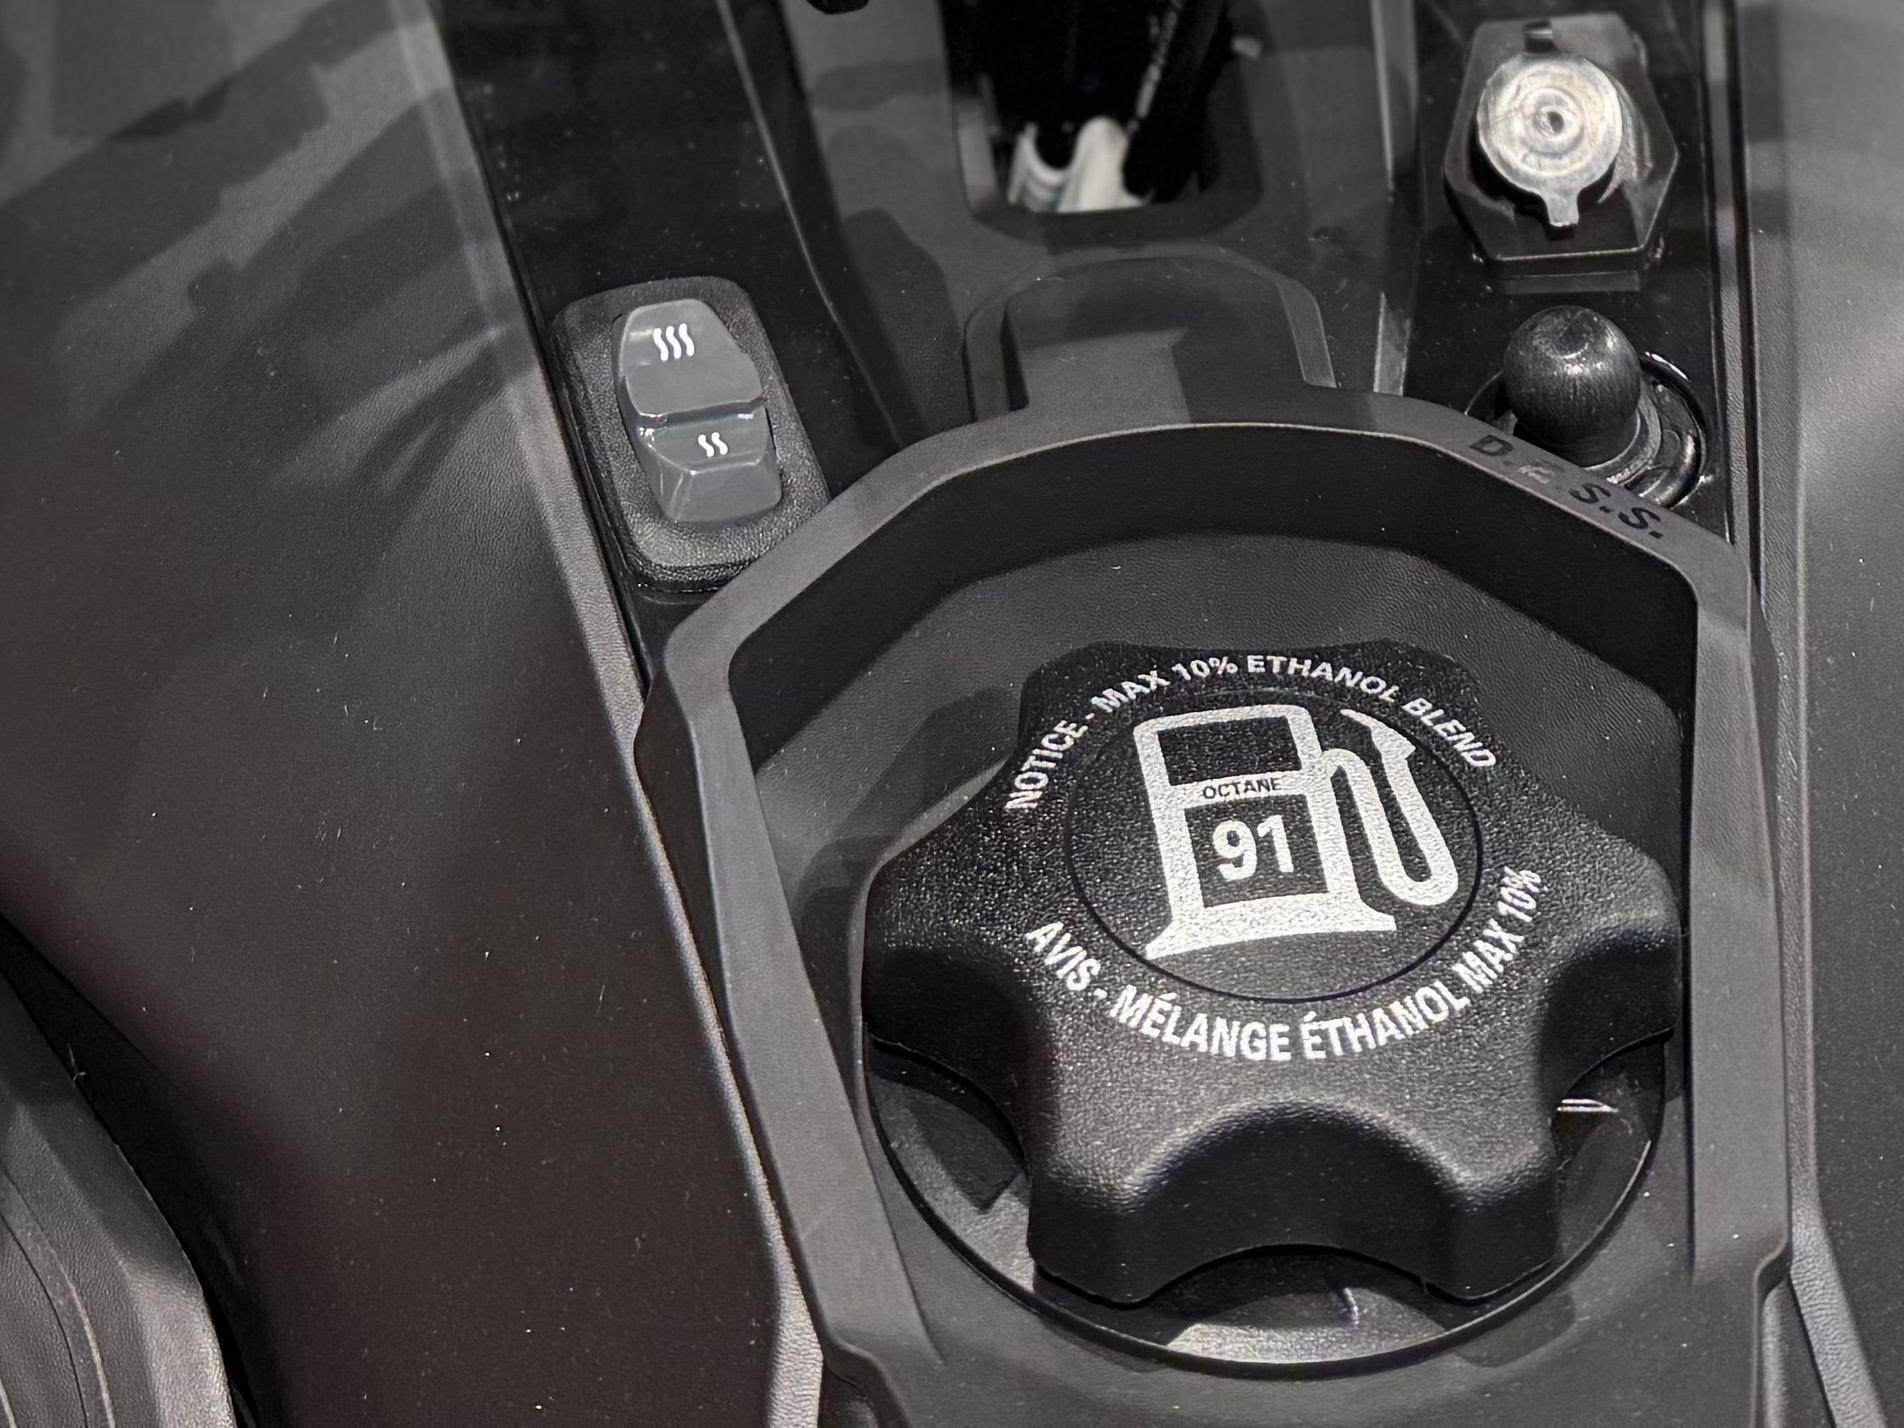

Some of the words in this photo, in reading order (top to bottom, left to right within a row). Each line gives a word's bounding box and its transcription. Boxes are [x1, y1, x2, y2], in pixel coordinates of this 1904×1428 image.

[1005, 719, 1087, 811] NOTICE
[1090, 669, 1170, 715] MAX
[1172, 655, 1239, 683] 10%
[1247, 654, 1402, 704] ETHANOL
[1401, 696, 1497, 769] BLEND
[1203, 777, 1282, 800] OCTANE
[1212, 814, 1295, 882] 91
[1024, 920, 1101, 992] AVIS
[1109, 983, 1293, 1062] MÉLANGE
[1302, 979, 1472, 1062] ÉTHANOL
[1450, 918, 1528, 995] MAX
[1498, 864, 1544, 925] 10%
